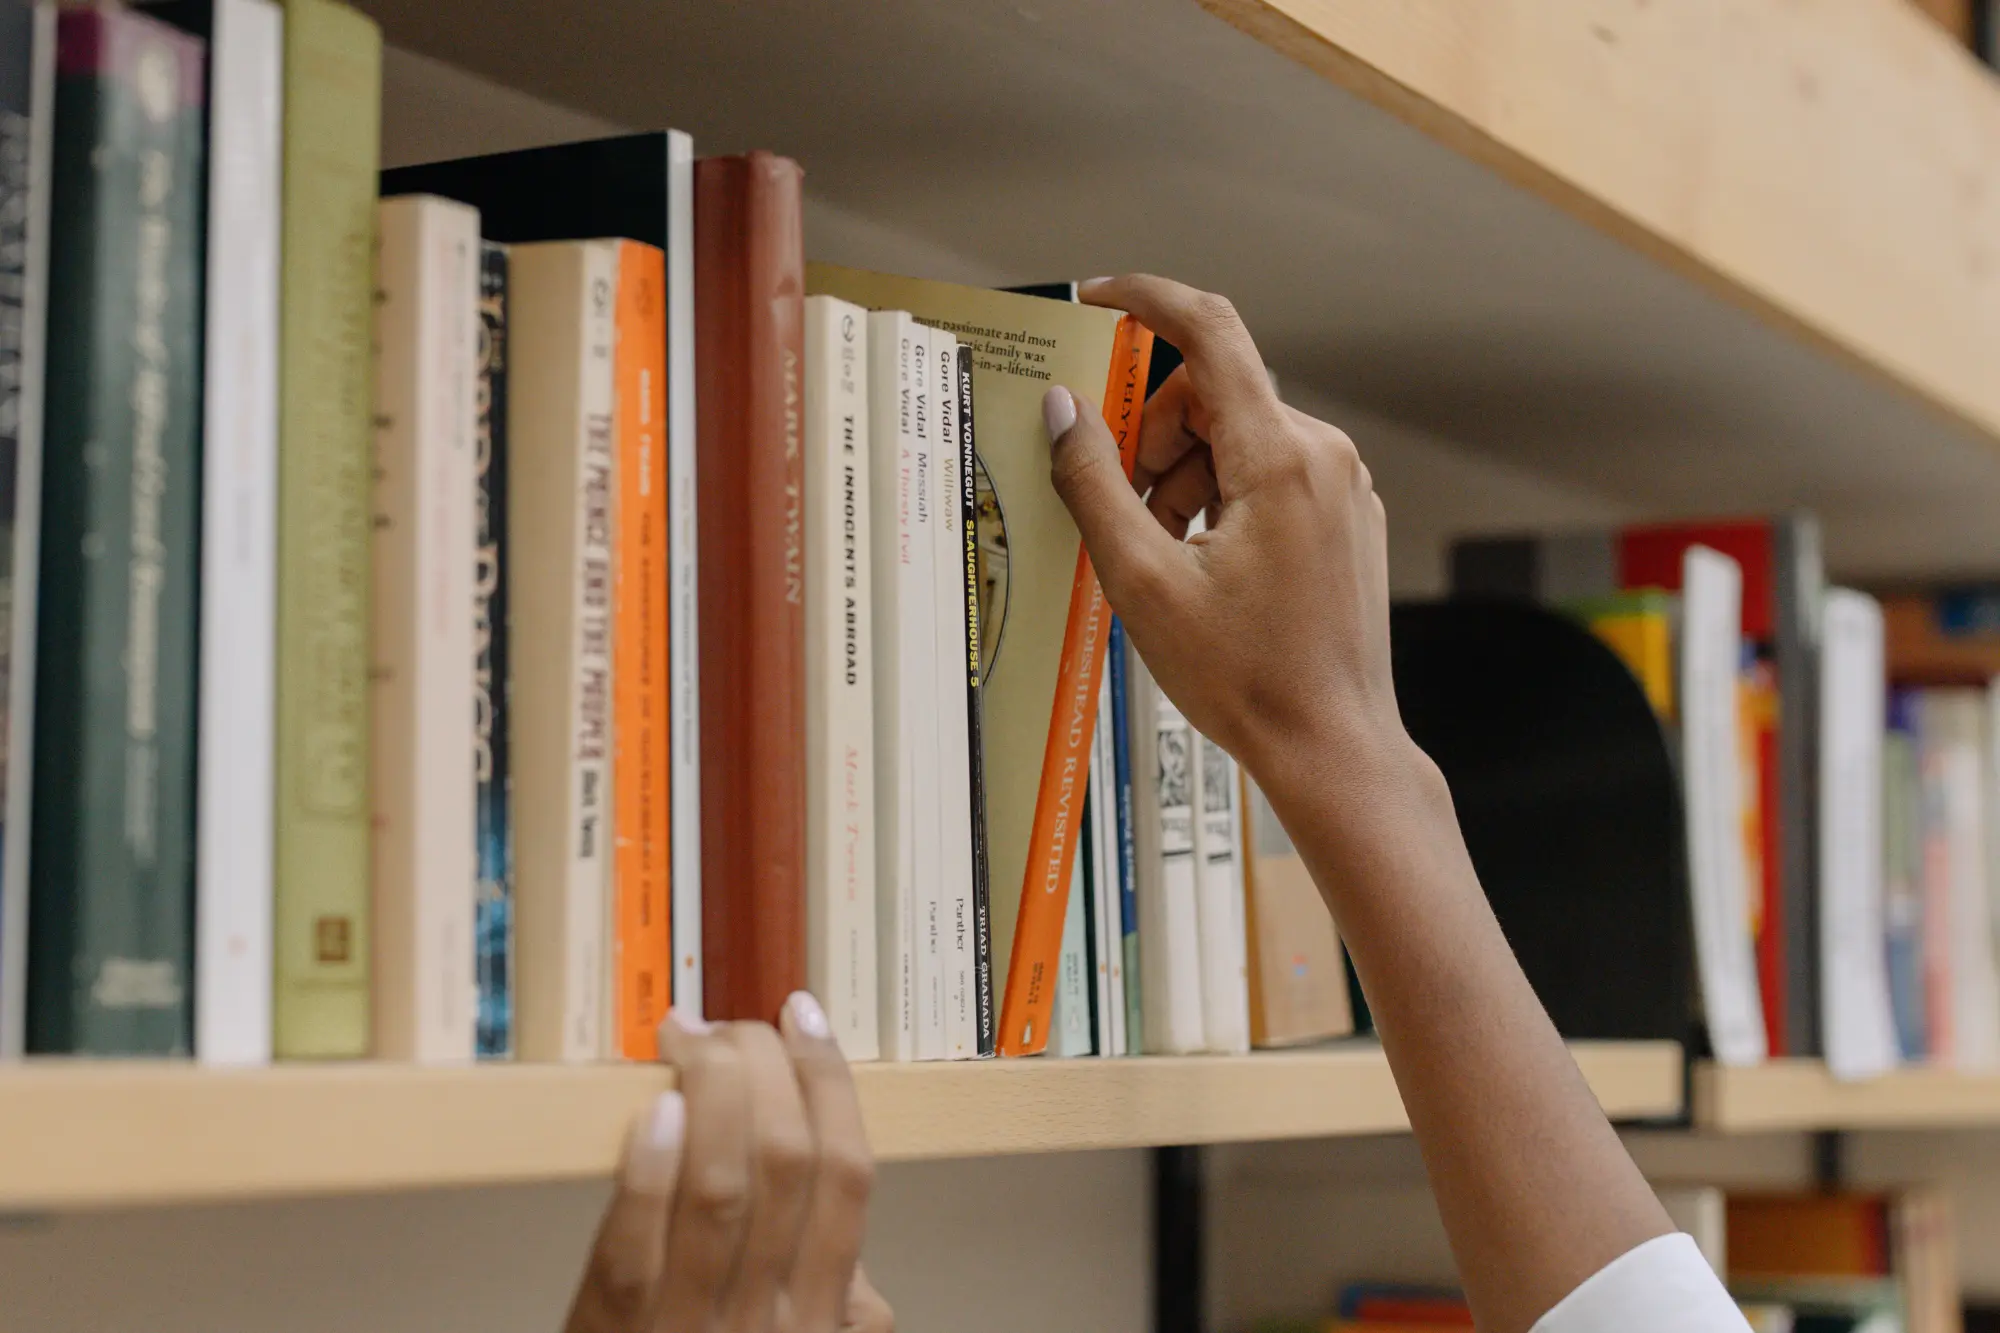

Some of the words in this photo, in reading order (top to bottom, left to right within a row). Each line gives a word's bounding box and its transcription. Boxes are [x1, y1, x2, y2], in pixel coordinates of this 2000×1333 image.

[900, 338, 912, 382] Gore
[941, 320, 1003, 339] passionate
[1003, 331, 1026, 344] and
[1027, 337, 1057, 349] most
[985, 342, 1022, 363] family
[1024, 352, 1046, 363] was
[914, 344, 926, 388] Gore
[940, 350, 951, 393] Gore
[972, 357, 1053, 381] -in-a-lifetime
[783, 349, 800, 460] MARK
[901, 388, 912, 435] Vidal
[915, 393, 927, 439] Vidal
[961, 371, 972, 418] KURT
[844, 414, 856, 457] THE
[941, 399, 953, 444] Vidal
[916, 452, 929, 523] Messiah
[962, 421, 974, 509] VONNEGUT
[943, 458, 955, 532] Williwaw
[785, 481, 802, 606] TWAIN
[844, 466, 857, 589] INNOCENTS
[965, 519, 979, 672] SLAUGHTERHOUSE
[844, 597, 858, 687] ABROAD
[1068, 580, 1103, 748] BRIDESHEAD
[969, 675, 979, 688] 5
[1045, 756, 1078, 894] REVISITED
[955, 897, 967, 953] Panther
[979, 905, 988, 956] TRIAD
[980, 961, 990, 1040] GRANADA
